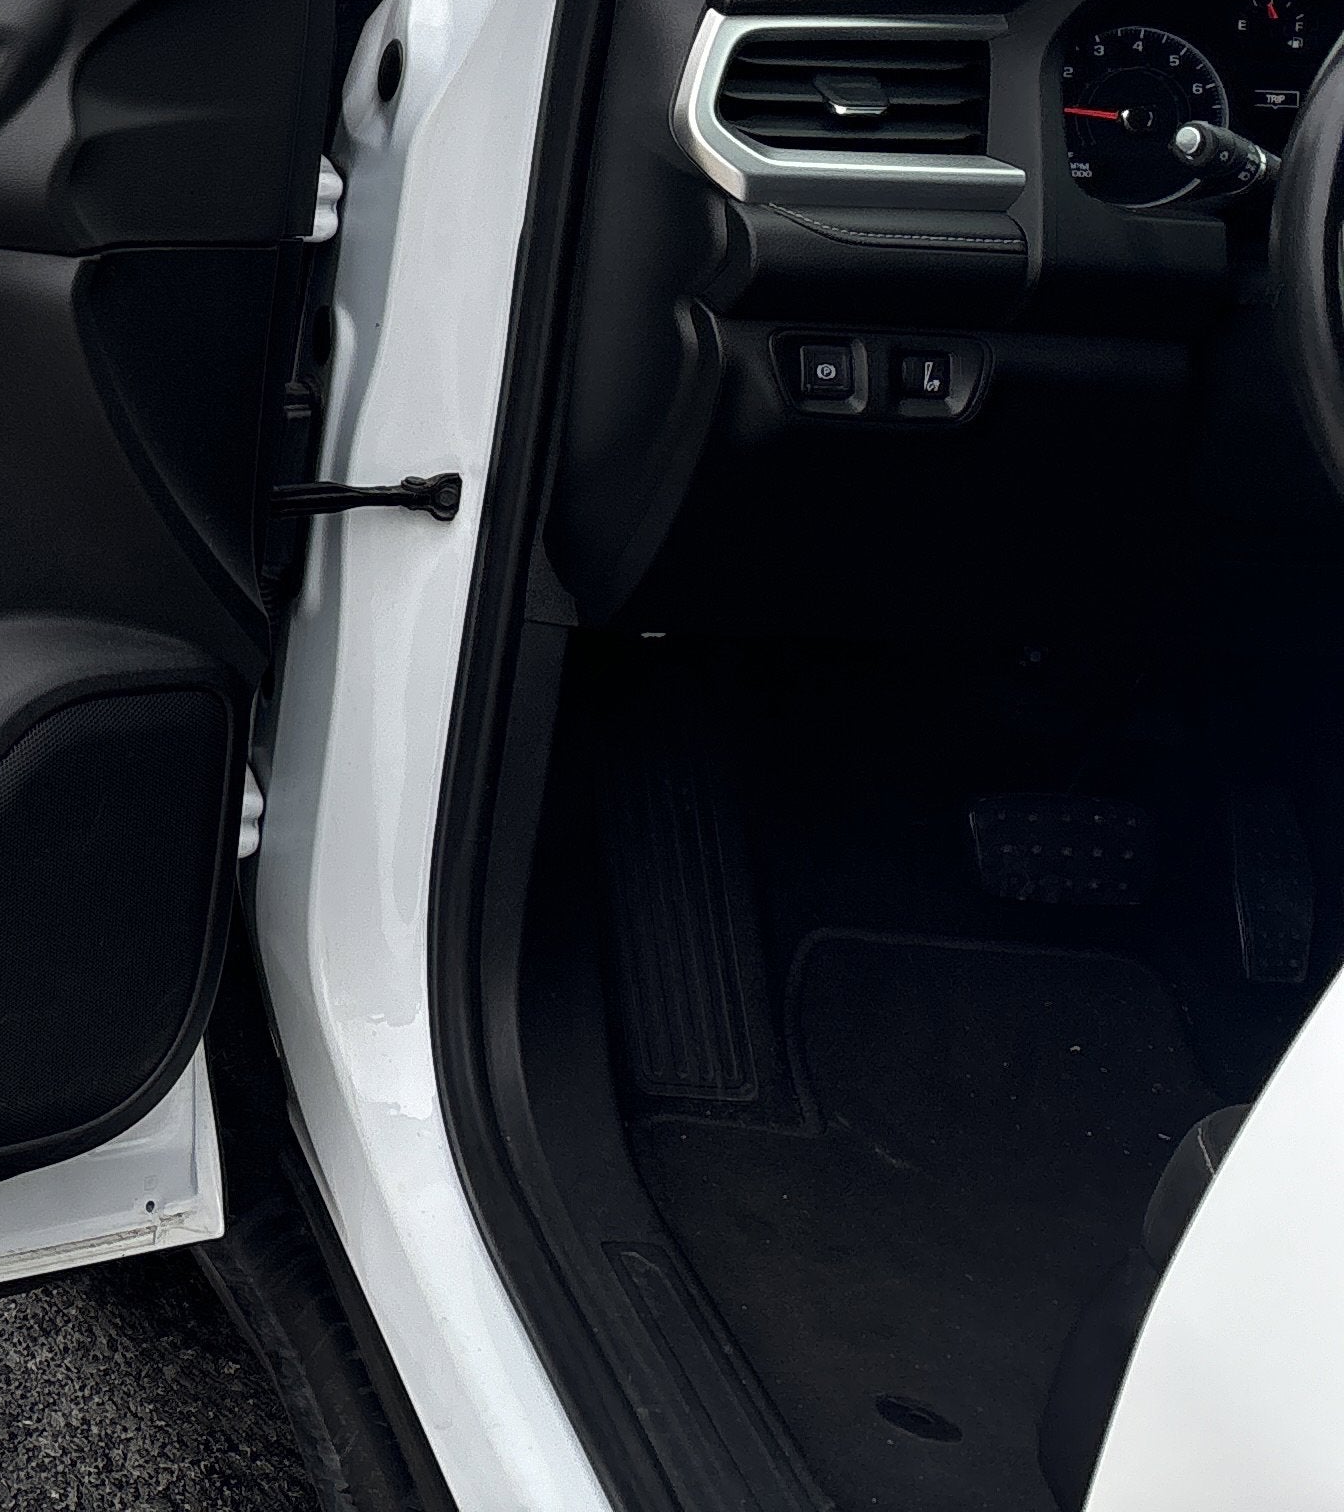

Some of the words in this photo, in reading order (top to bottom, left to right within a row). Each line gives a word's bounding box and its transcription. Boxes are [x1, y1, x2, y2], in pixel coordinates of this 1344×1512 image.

[1238, 19, 1247, 30] E
[1295, 21, 1304, 33] F
[1094, 45, 1105, 56] 3
[1132, 40, 1143, 52] 4
[1169, 55, 1180, 66] 5
[1063, 66, 1074, 78] 2
[1192, 83, 1203, 94] 6
